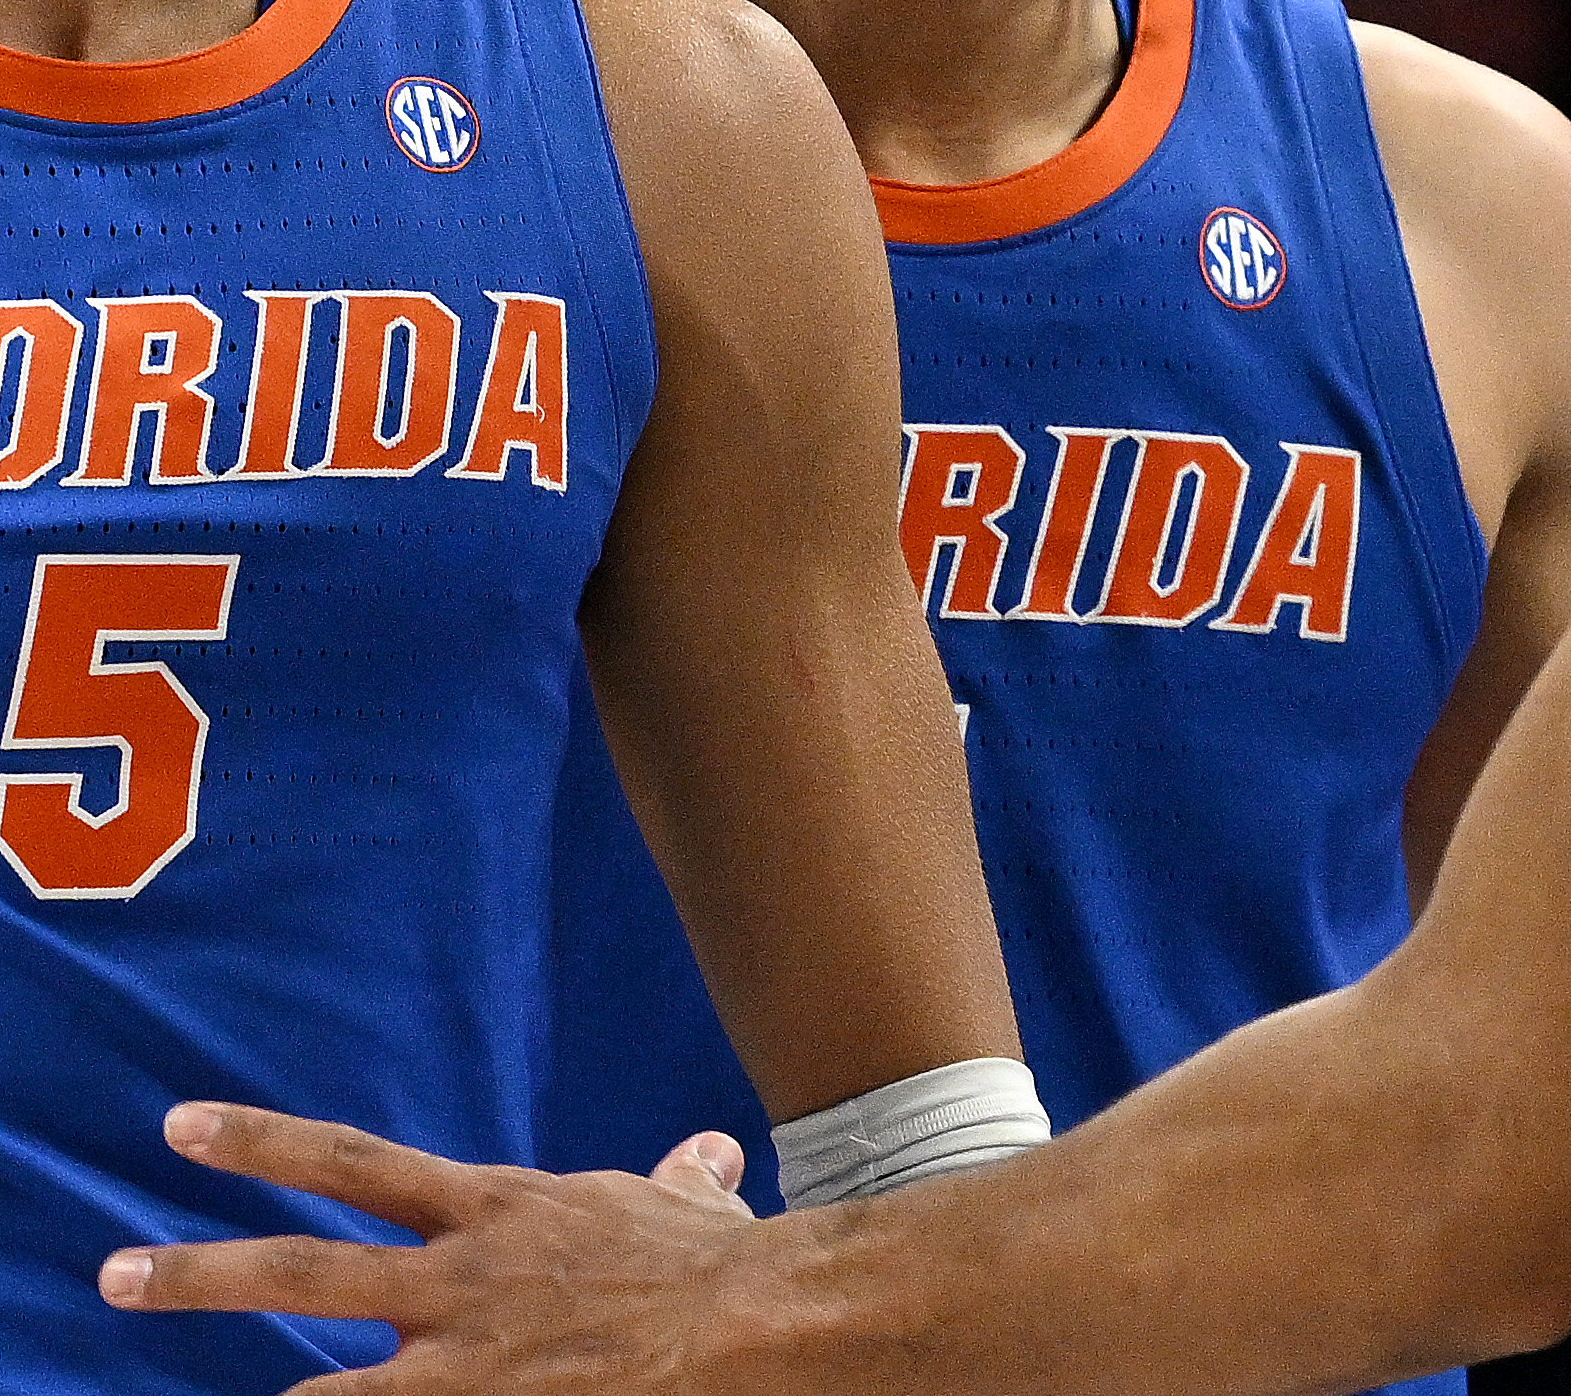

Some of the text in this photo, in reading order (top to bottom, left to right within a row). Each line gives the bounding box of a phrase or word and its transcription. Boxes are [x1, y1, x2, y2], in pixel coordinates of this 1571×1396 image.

[391, 82, 473, 167] SEC
[1206, 214, 1279, 301] SEC
[898, 423, 1362, 643] RIDA
